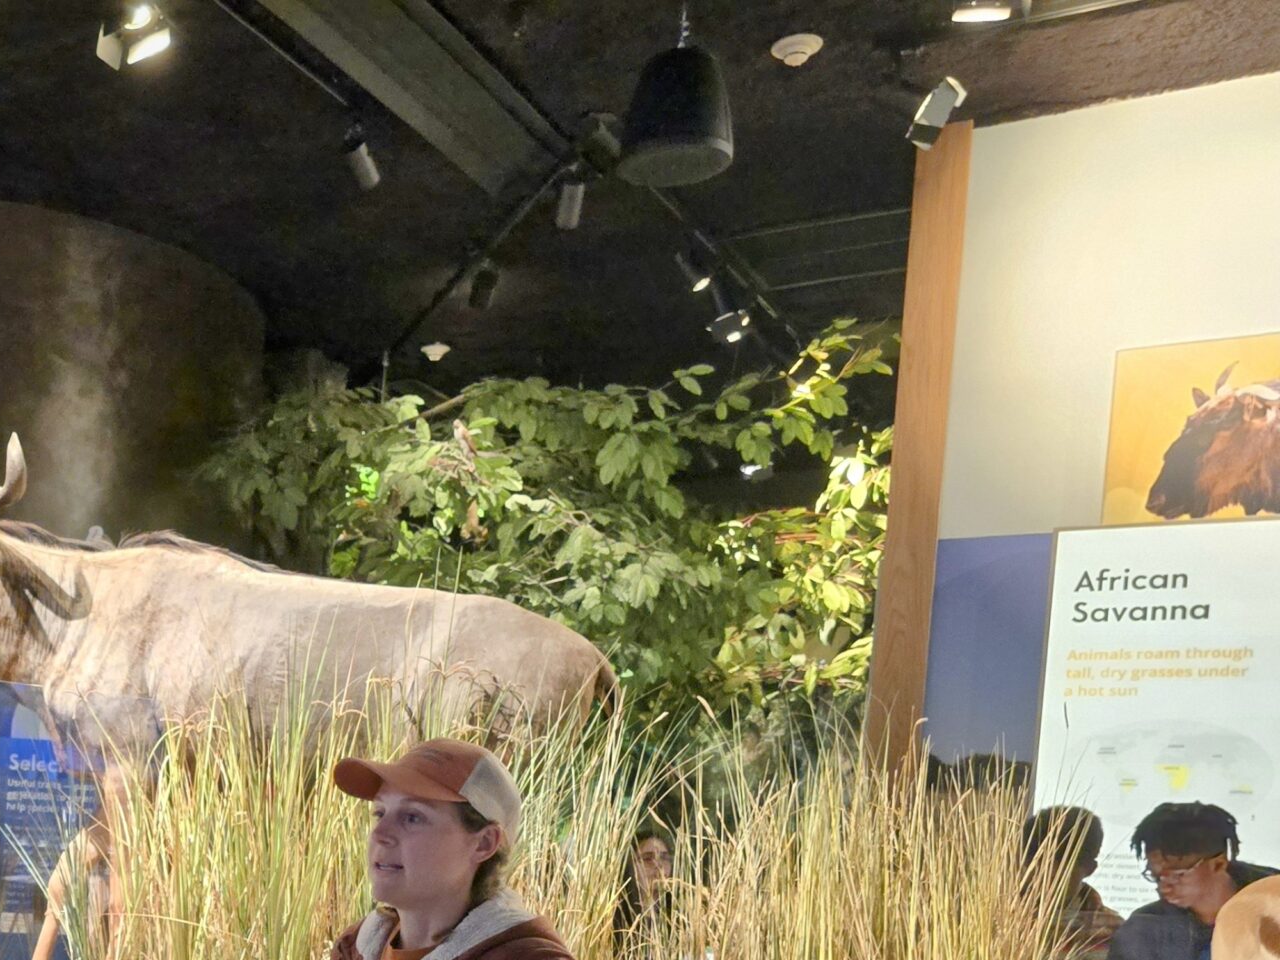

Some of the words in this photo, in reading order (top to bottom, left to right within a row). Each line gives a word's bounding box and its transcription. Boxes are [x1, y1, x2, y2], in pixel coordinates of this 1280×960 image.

[1074, 568, 1188, 592] African
[1072, 602, 1210, 623] Savanna
[1066, 649, 1132, 661] Animals
[1136, 650, 1181, 660] roam
[1185, 647, 1254, 661] through
[1066, 667, 1094, 680] tall,
[1100, 667, 1127, 681] dry
[1130, 667, 1193, 681] grasses
[1197, 665, 1249, 678] under
[1063, 687, 1073, 697] a
[1078, 685, 1104, 697] hot
[1109, 686, 1139, 697] sun
